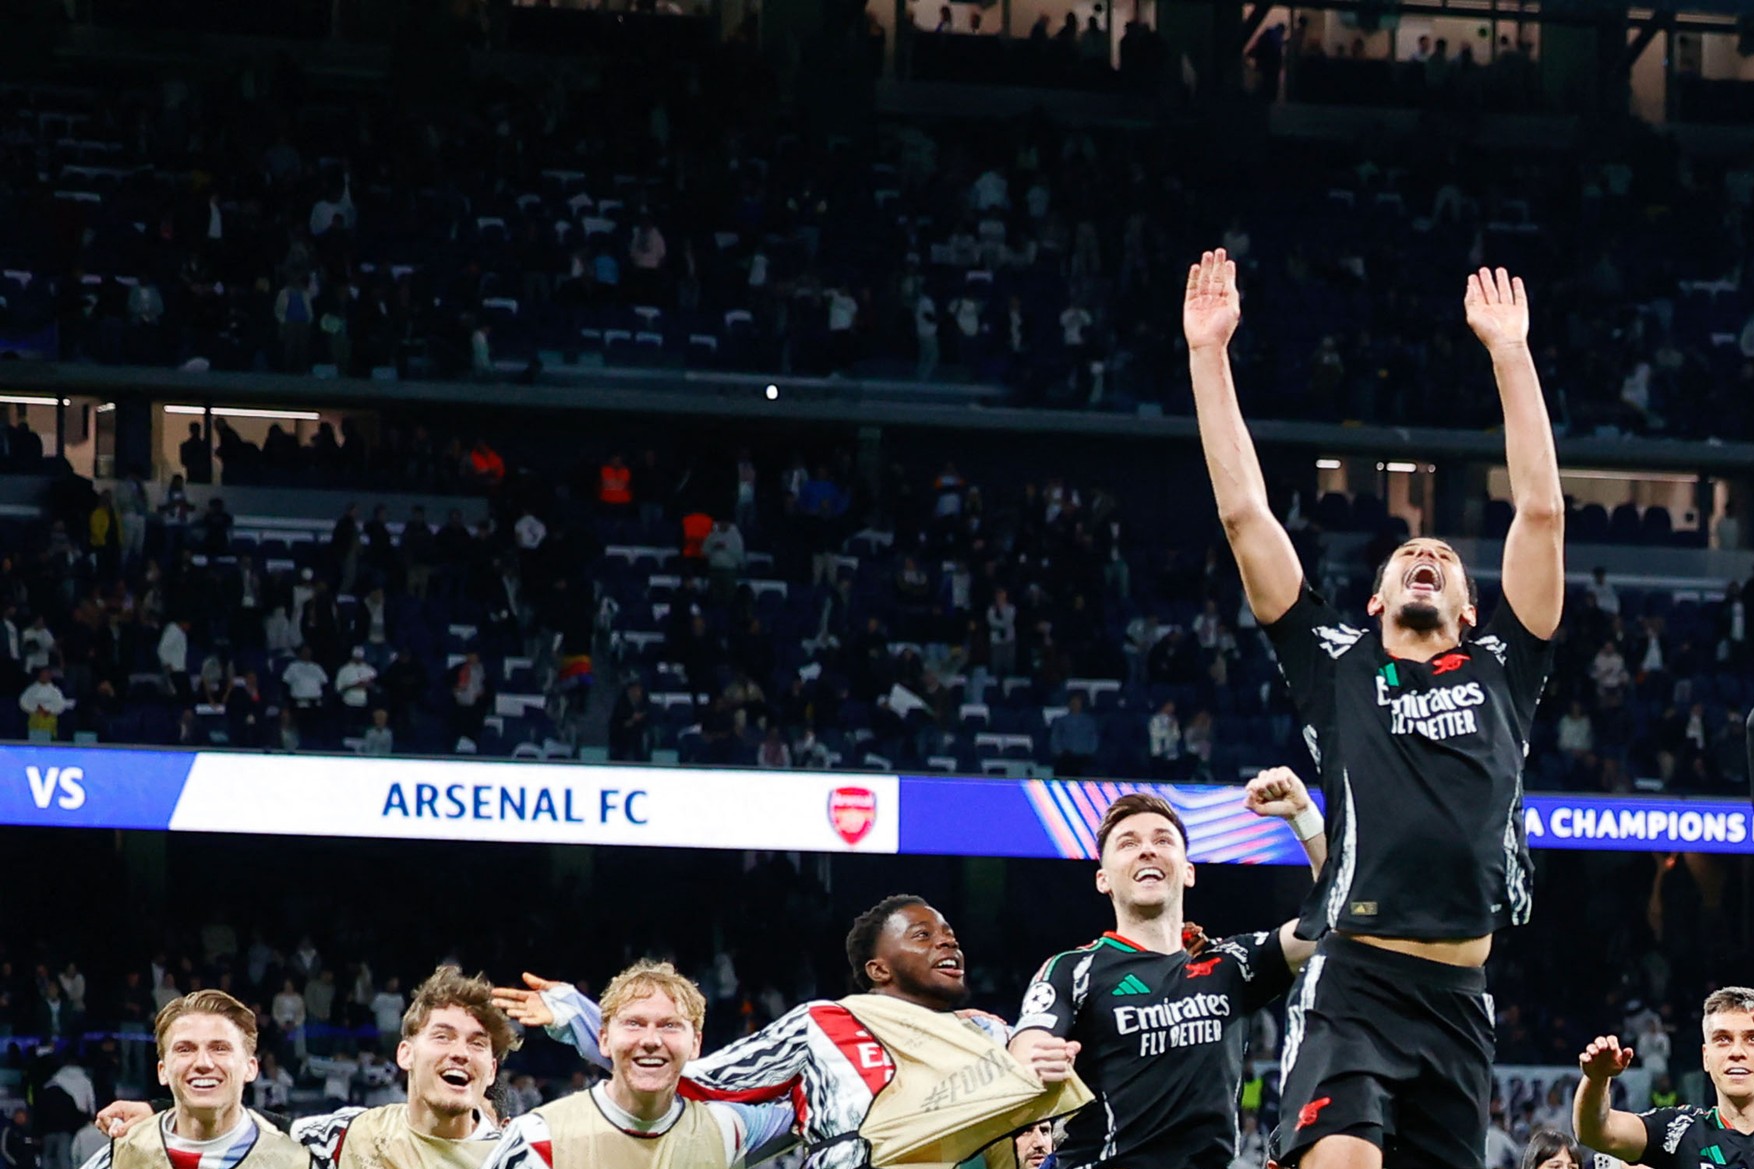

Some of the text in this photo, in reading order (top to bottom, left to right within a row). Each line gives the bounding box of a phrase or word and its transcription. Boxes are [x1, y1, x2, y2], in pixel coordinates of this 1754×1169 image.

[26, 766, 87, 808] VS
[381, 782, 650, 825] ARSENAL FC
[1549, 807, 1748, 844] CHAMPIONS
[1112, 992, 1231, 1036] Emirates
[1139, 1018, 1223, 1058] FLY BETTER
